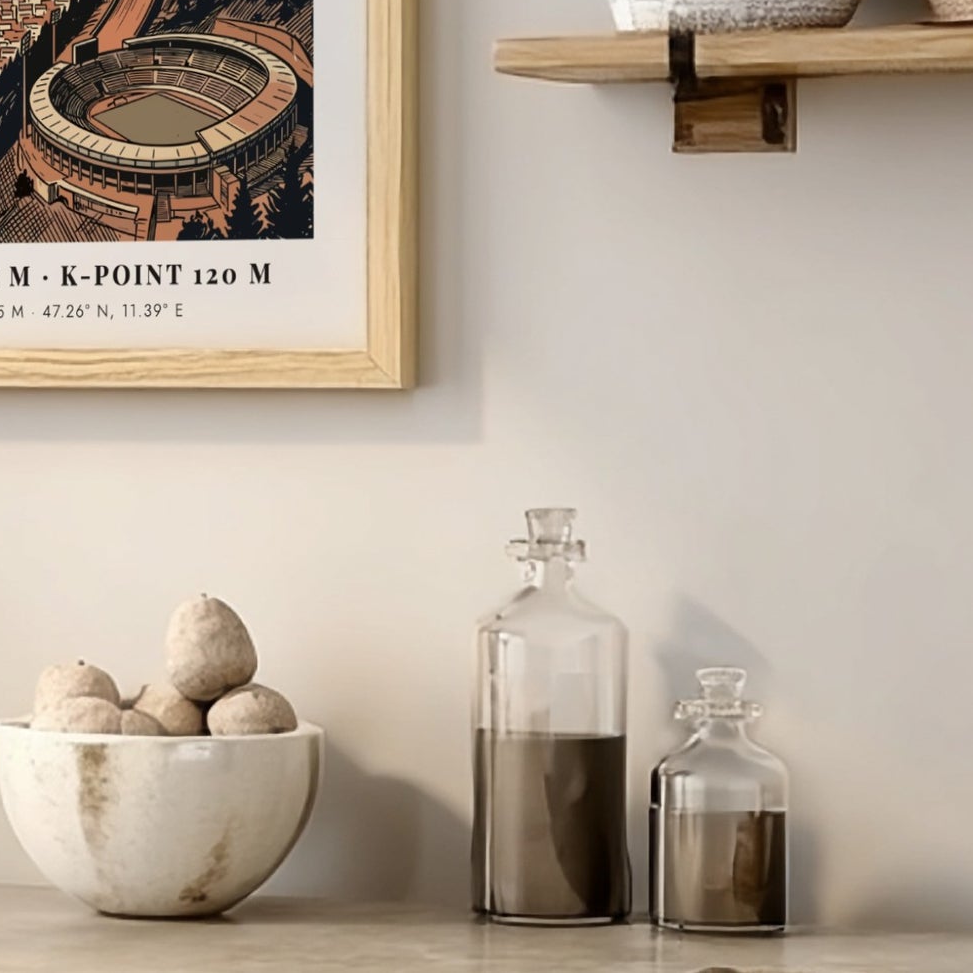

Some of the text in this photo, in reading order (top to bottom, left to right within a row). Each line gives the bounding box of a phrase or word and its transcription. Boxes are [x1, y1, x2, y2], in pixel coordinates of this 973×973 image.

[9, 265, 30, 288] M
[60, 263, 183, 287] K-POINT
[193, 268, 237, 286] 120
[249, 262, 271, 285] M
[11, 305, 24, 319] M
[42, 303, 90, 319] 47.26°
[97, 304, 114, 320] N,
[122, 303, 168, 318] 11.39°
[175, 303, 183, 318] E
